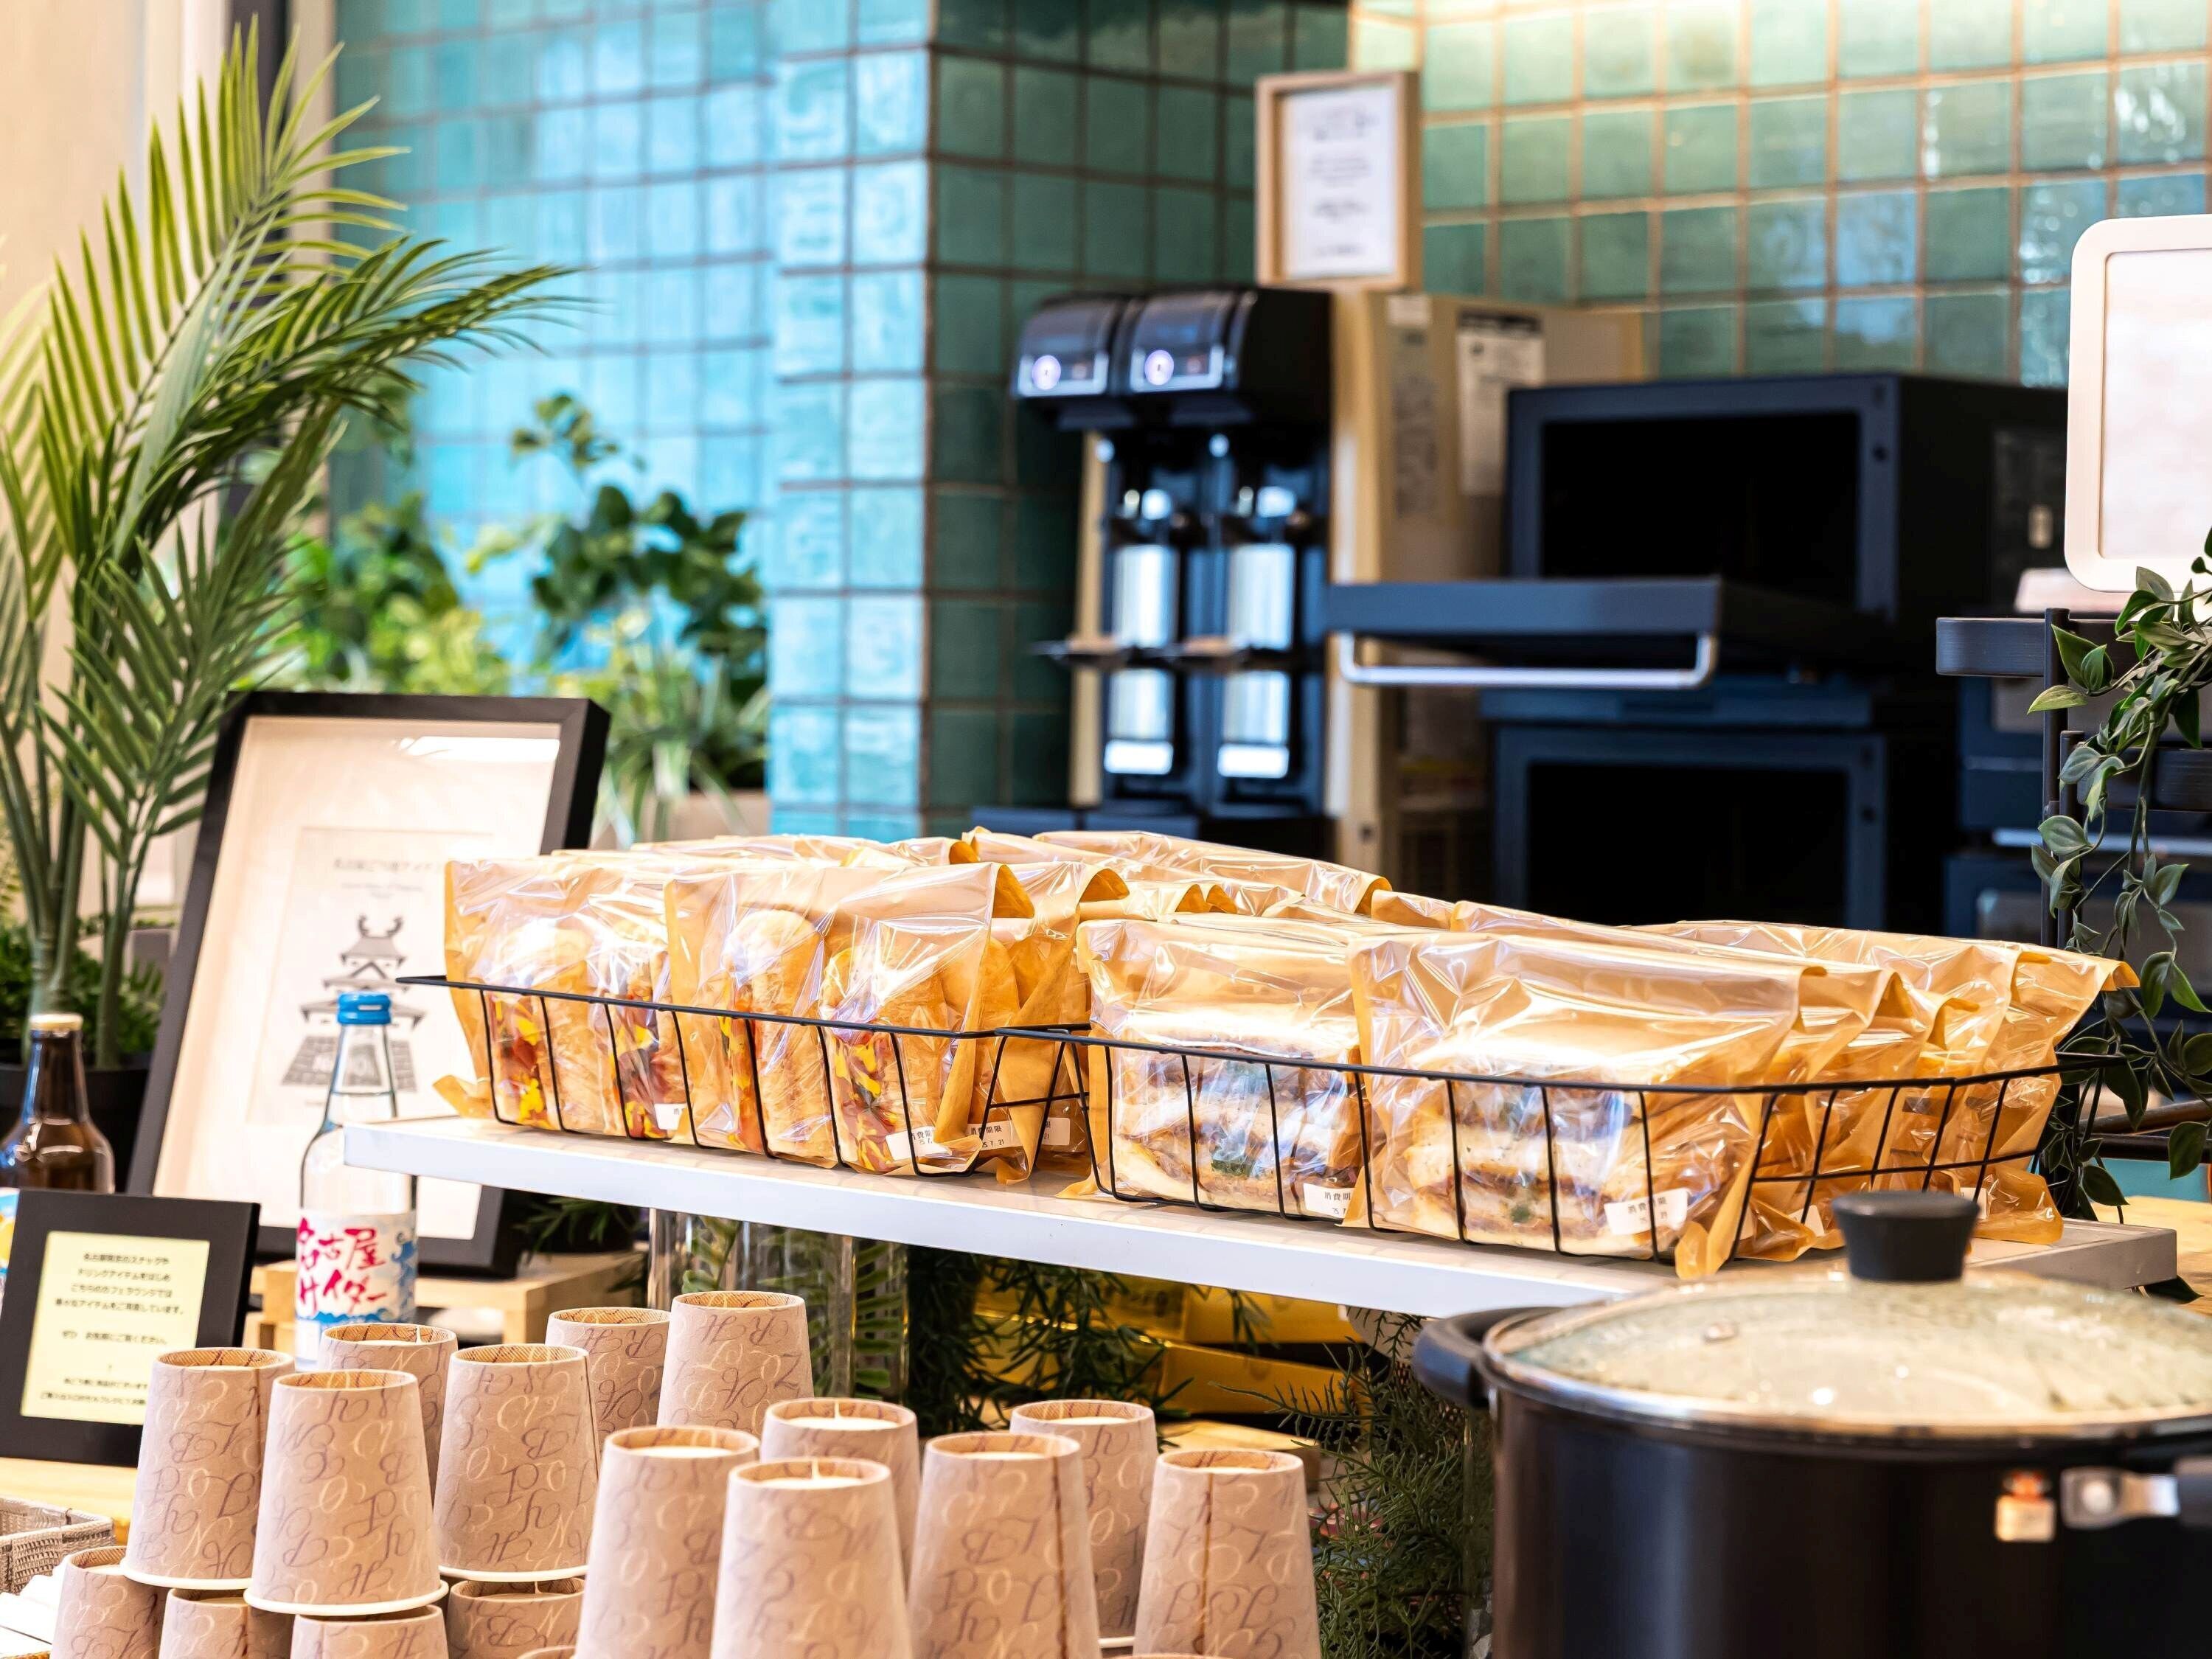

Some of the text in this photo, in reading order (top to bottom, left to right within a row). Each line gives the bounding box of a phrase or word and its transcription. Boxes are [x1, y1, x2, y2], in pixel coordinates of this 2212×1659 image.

[296, 1217, 386, 1270] 名古屋
[299, 1275, 387, 1316] サイダー
